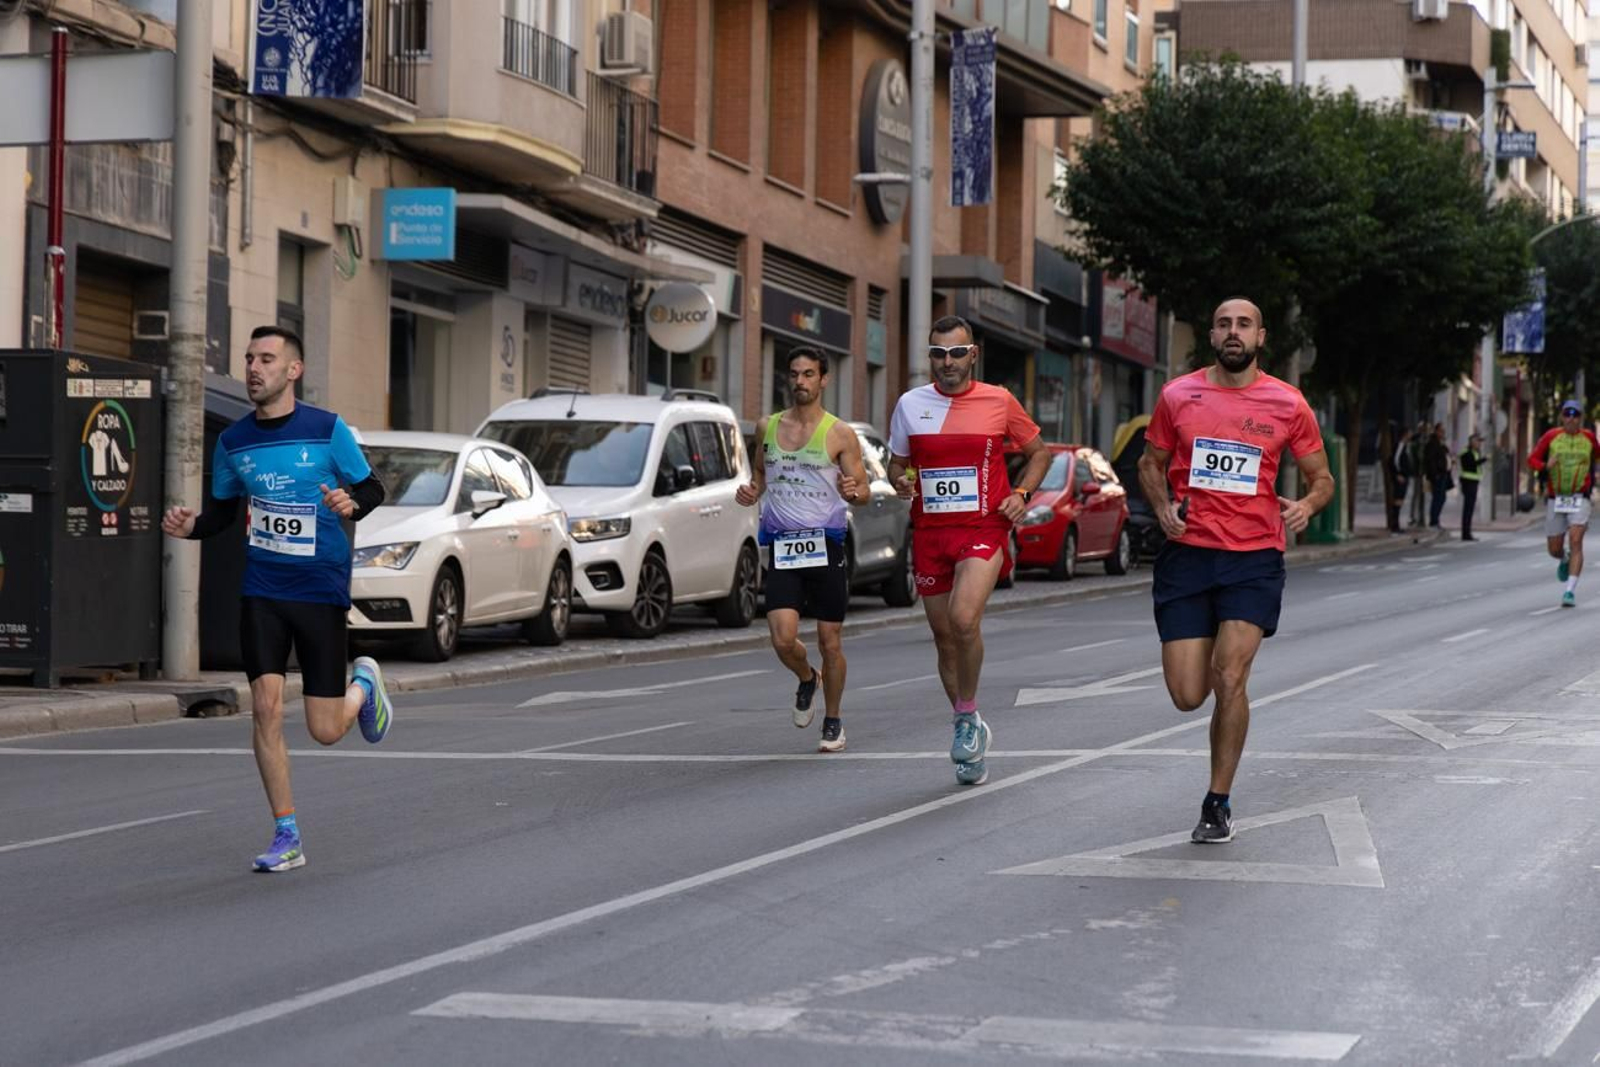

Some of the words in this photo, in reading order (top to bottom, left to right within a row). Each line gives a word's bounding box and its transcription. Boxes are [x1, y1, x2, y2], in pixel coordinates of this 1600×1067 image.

[391, 202, 443, 216] endesa
[668, 308, 709, 323] Jucar
[97, 413, 121, 429] ROPA
[1205, 453, 1248, 473] 907
[91, 480, 97, 491] Y
[97, 480, 127, 492] CALZADO
[935, 480, 961, 497] 60
[261, 514, 302, 536] 169
[784, 540, 816, 556] 700
